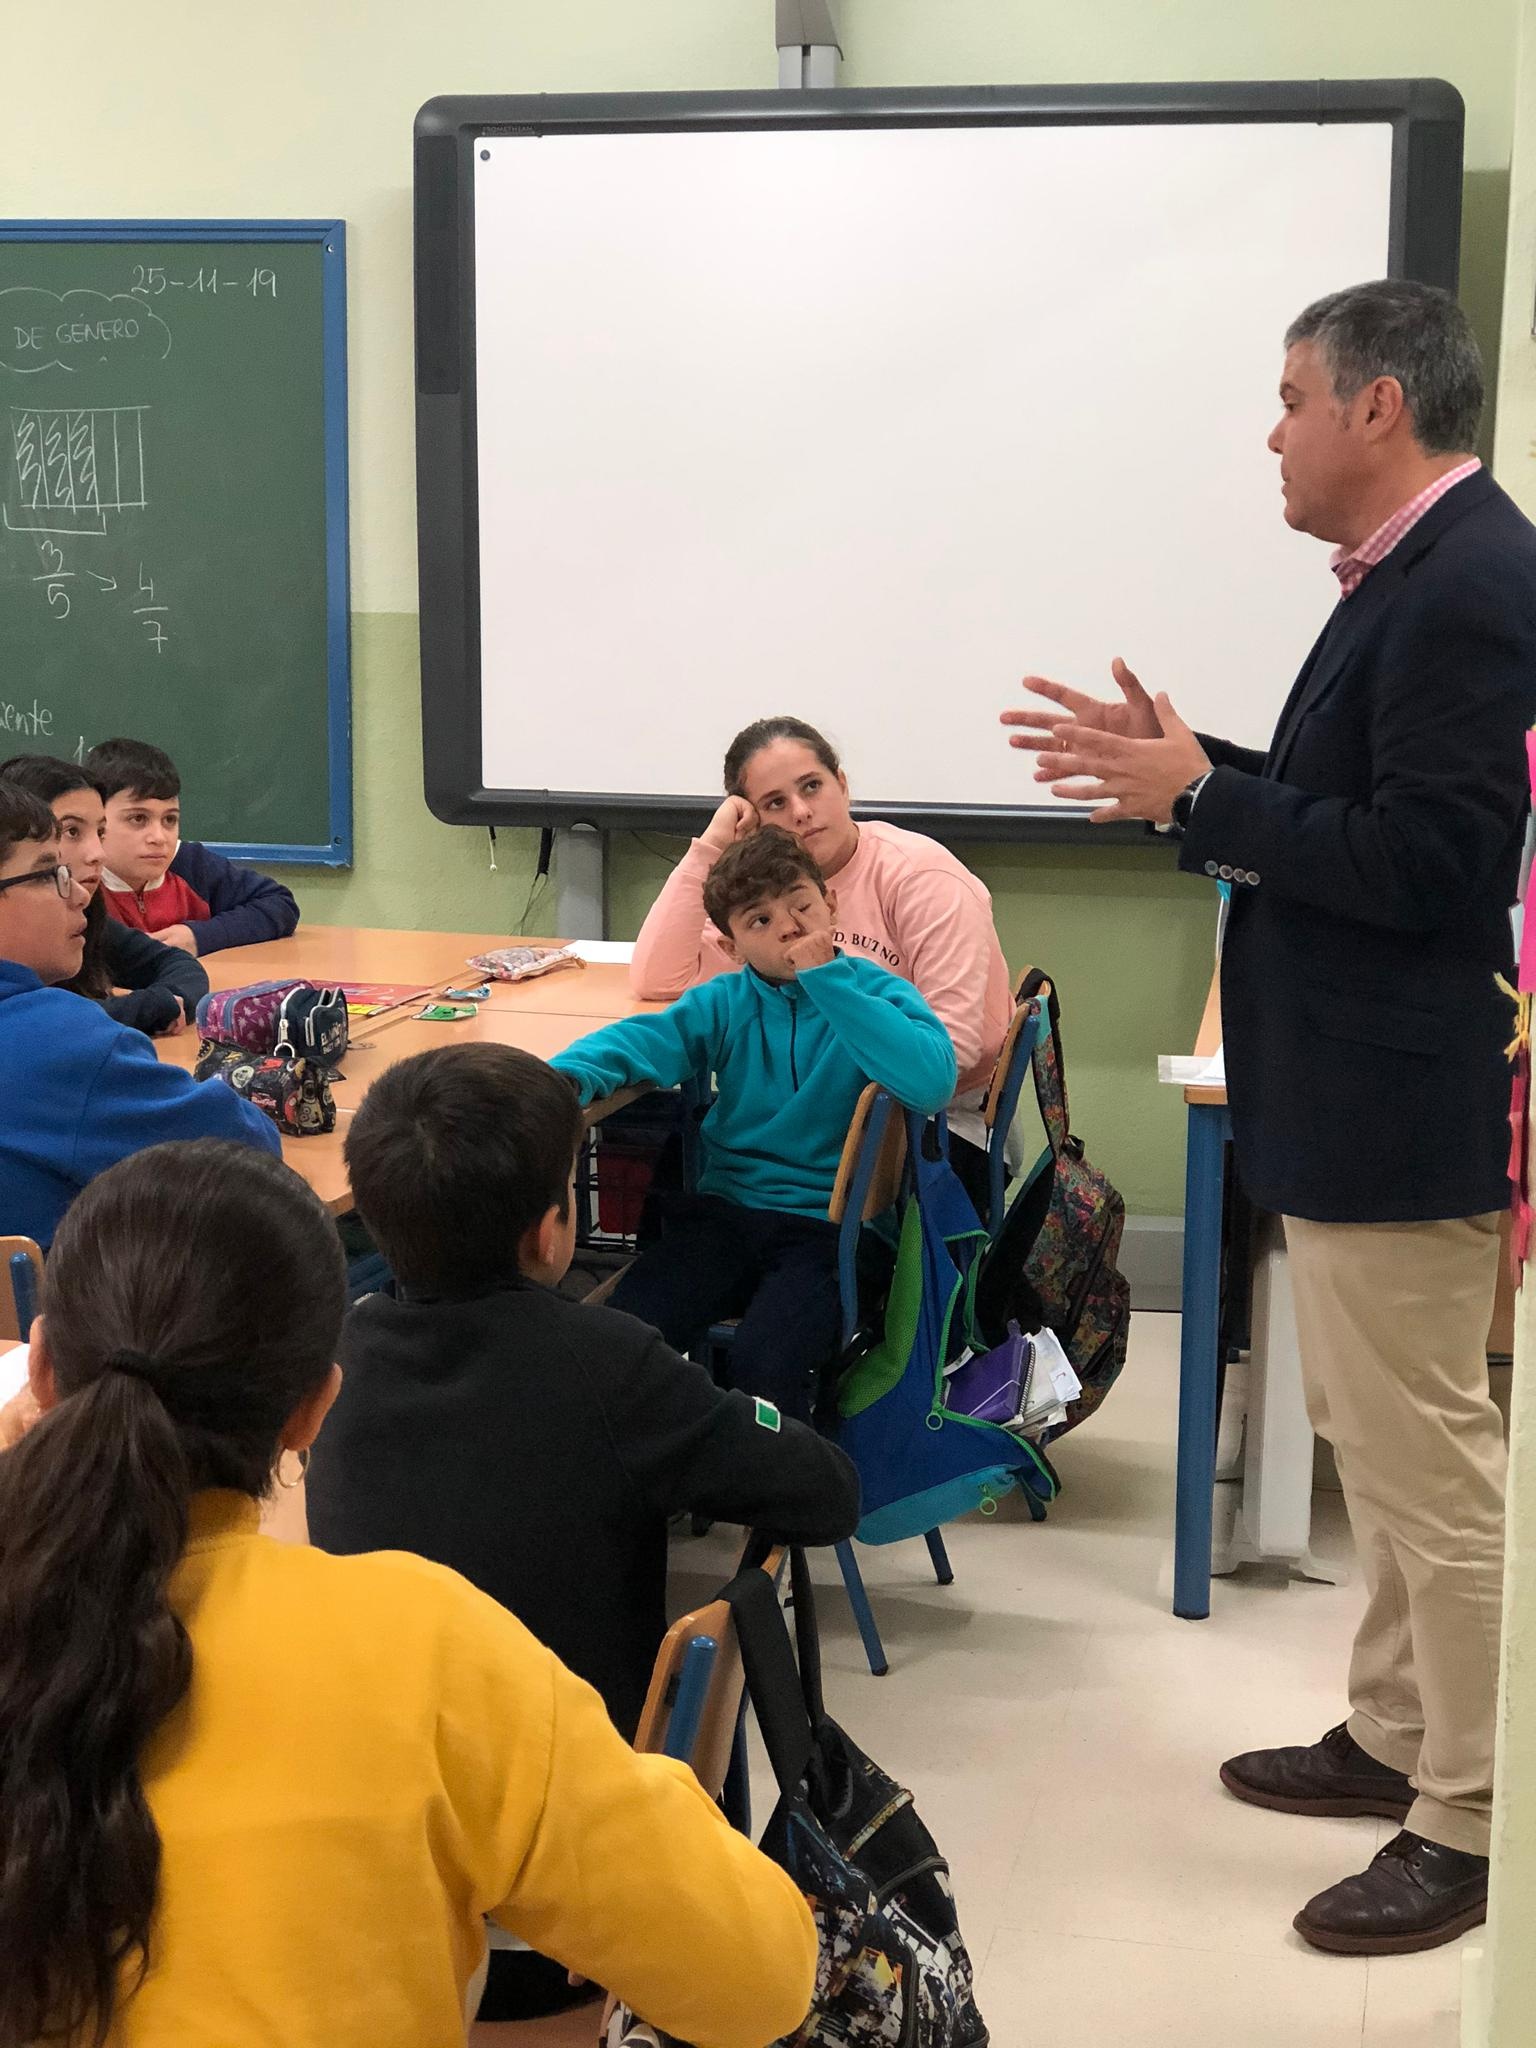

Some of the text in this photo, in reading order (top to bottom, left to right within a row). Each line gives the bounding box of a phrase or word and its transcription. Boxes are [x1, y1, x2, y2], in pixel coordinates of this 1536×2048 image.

[13, 326, 44, 350] DE
[41, 540, 64, 573] 3
[139, 561, 154, 600] 4
[47, 583, 70, 619] 5
[142, 620, 168, 654] 7
[851, 933, 880, 953] BUT
